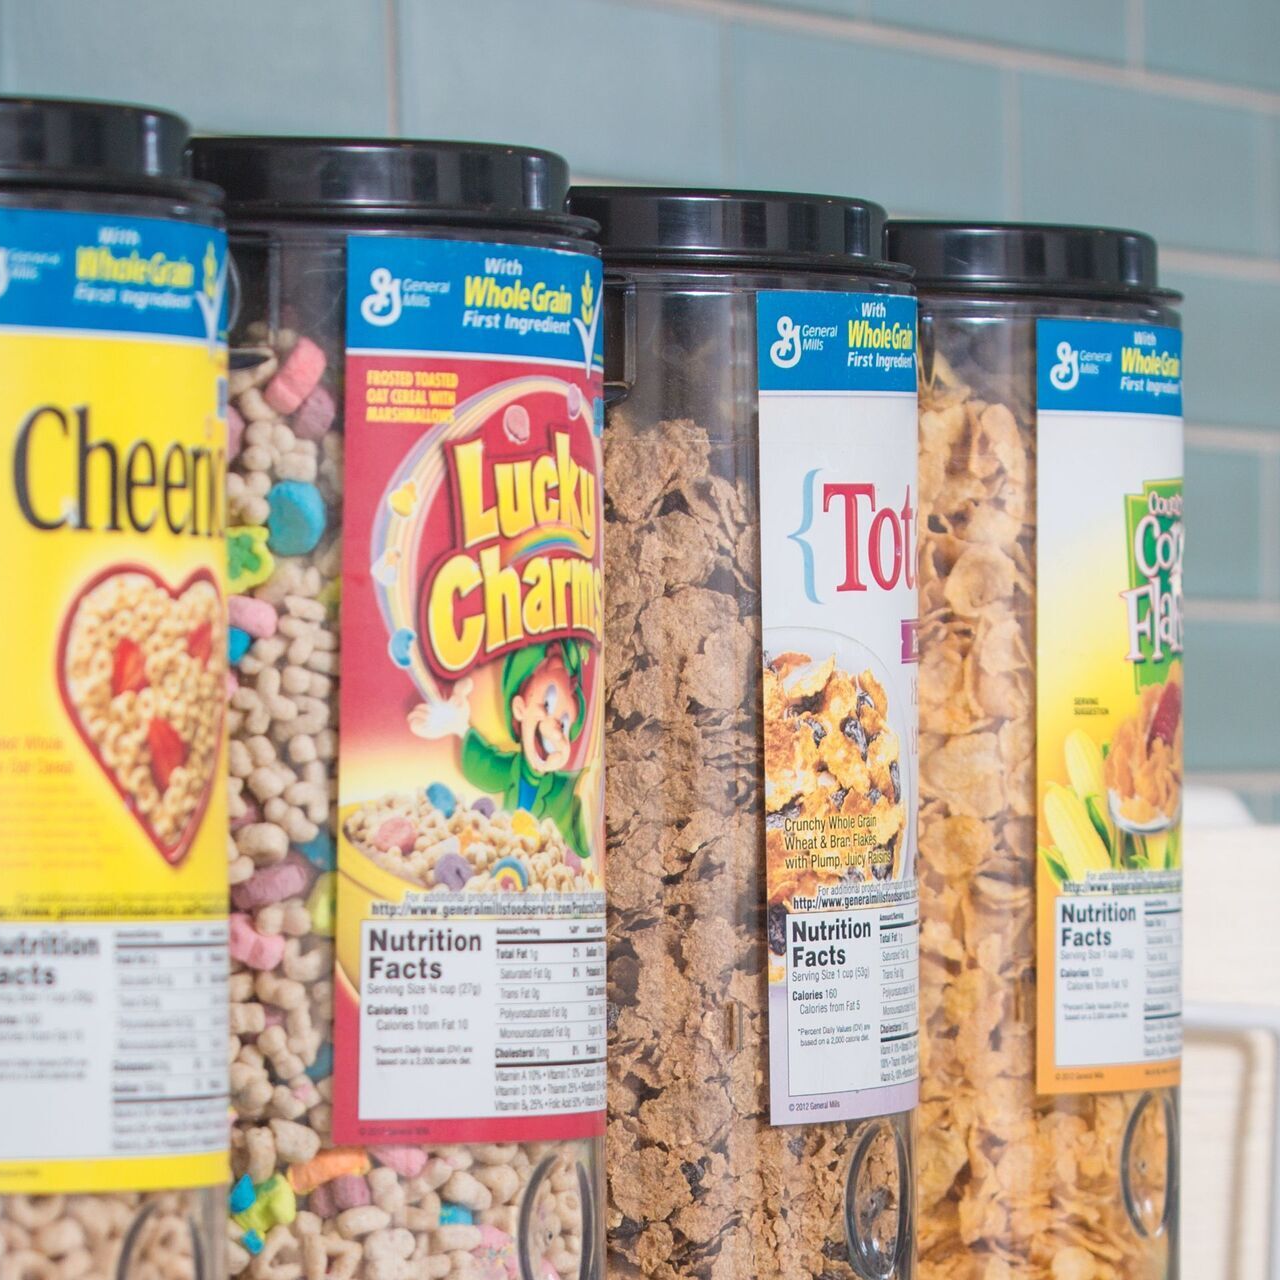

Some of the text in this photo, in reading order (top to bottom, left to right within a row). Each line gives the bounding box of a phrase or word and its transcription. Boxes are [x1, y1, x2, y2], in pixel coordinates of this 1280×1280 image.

[484, 257, 523, 276] With
[403, 278, 450, 293] General
[403, 294, 431, 307] Mills
[861, 302, 886, 318] With
[462, 311, 571, 335] First Ingredient
[802, 325, 837, 337] General
[1134, 331, 1157, 346] With
[803, 339, 824, 351] Mills
[847, 352, 912, 372] First Ingredient
[1080, 350, 1112, 362] General
[1080, 364, 1099, 374] Mills
[1120, 376, 1144, 391] First
[454, 432, 597, 548] Lucky
[784, 815, 877, 833] Crunchy Whole Grain
[784, 833, 877, 850] Wheat & Bran Flakes
[785, 851, 891, 870] with Plump, Juicy Raisins
[1061, 903, 1136, 923] Nutrition
[792, 918, 871, 943] Nutrition
[1061, 928, 1112, 947] Facts
[369, 928, 482, 951] Nutrition
[496, 948, 514, 959] Total
[793, 945, 846, 968] Facts
[369, 957, 443, 979] Facts
[1061, 968, 1089, 978] Calories
[792, 970, 819, 983] Serving
[821, 969, 835, 980] Size
[842, 969, 853, 979] cup
[792, 988, 838, 1001] Calories 160
[367, 1004, 408, 1015] Calories
[800, 1003, 828, 1014] Calories
[830, 1002, 844, 1013] from
[846, 1001, 855, 1011] Fat
[377, 1020, 415, 1031] Calories
